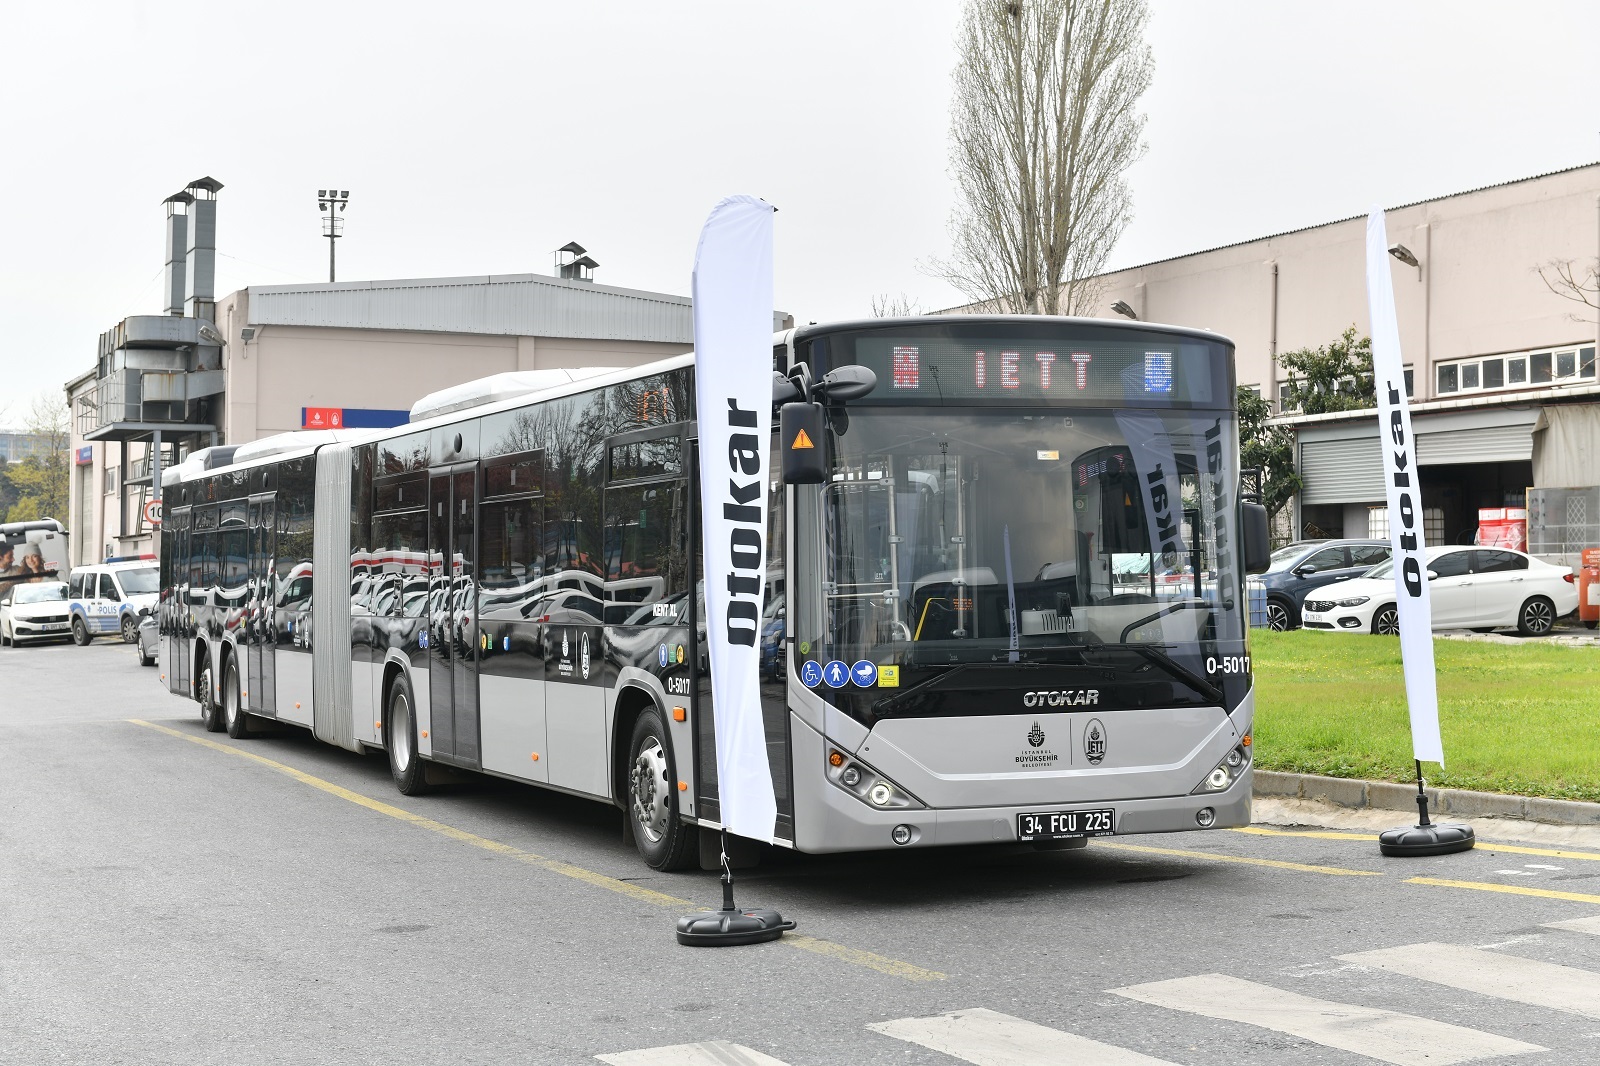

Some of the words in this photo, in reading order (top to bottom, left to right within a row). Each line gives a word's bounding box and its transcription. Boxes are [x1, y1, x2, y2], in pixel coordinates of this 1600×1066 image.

[1387, 381, 1422, 598] otokar
[723, 398, 761, 648] otokar
[652, 604, 669, 617] KENT
[669, 605, 678, 617] XL
[1023, 689, 1099, 707] OTOKAR
[1025, 817, 1042, 833] 34
[1051, 815, 1077, 833] FCU
[1085, 813, 1110, 831] 225
